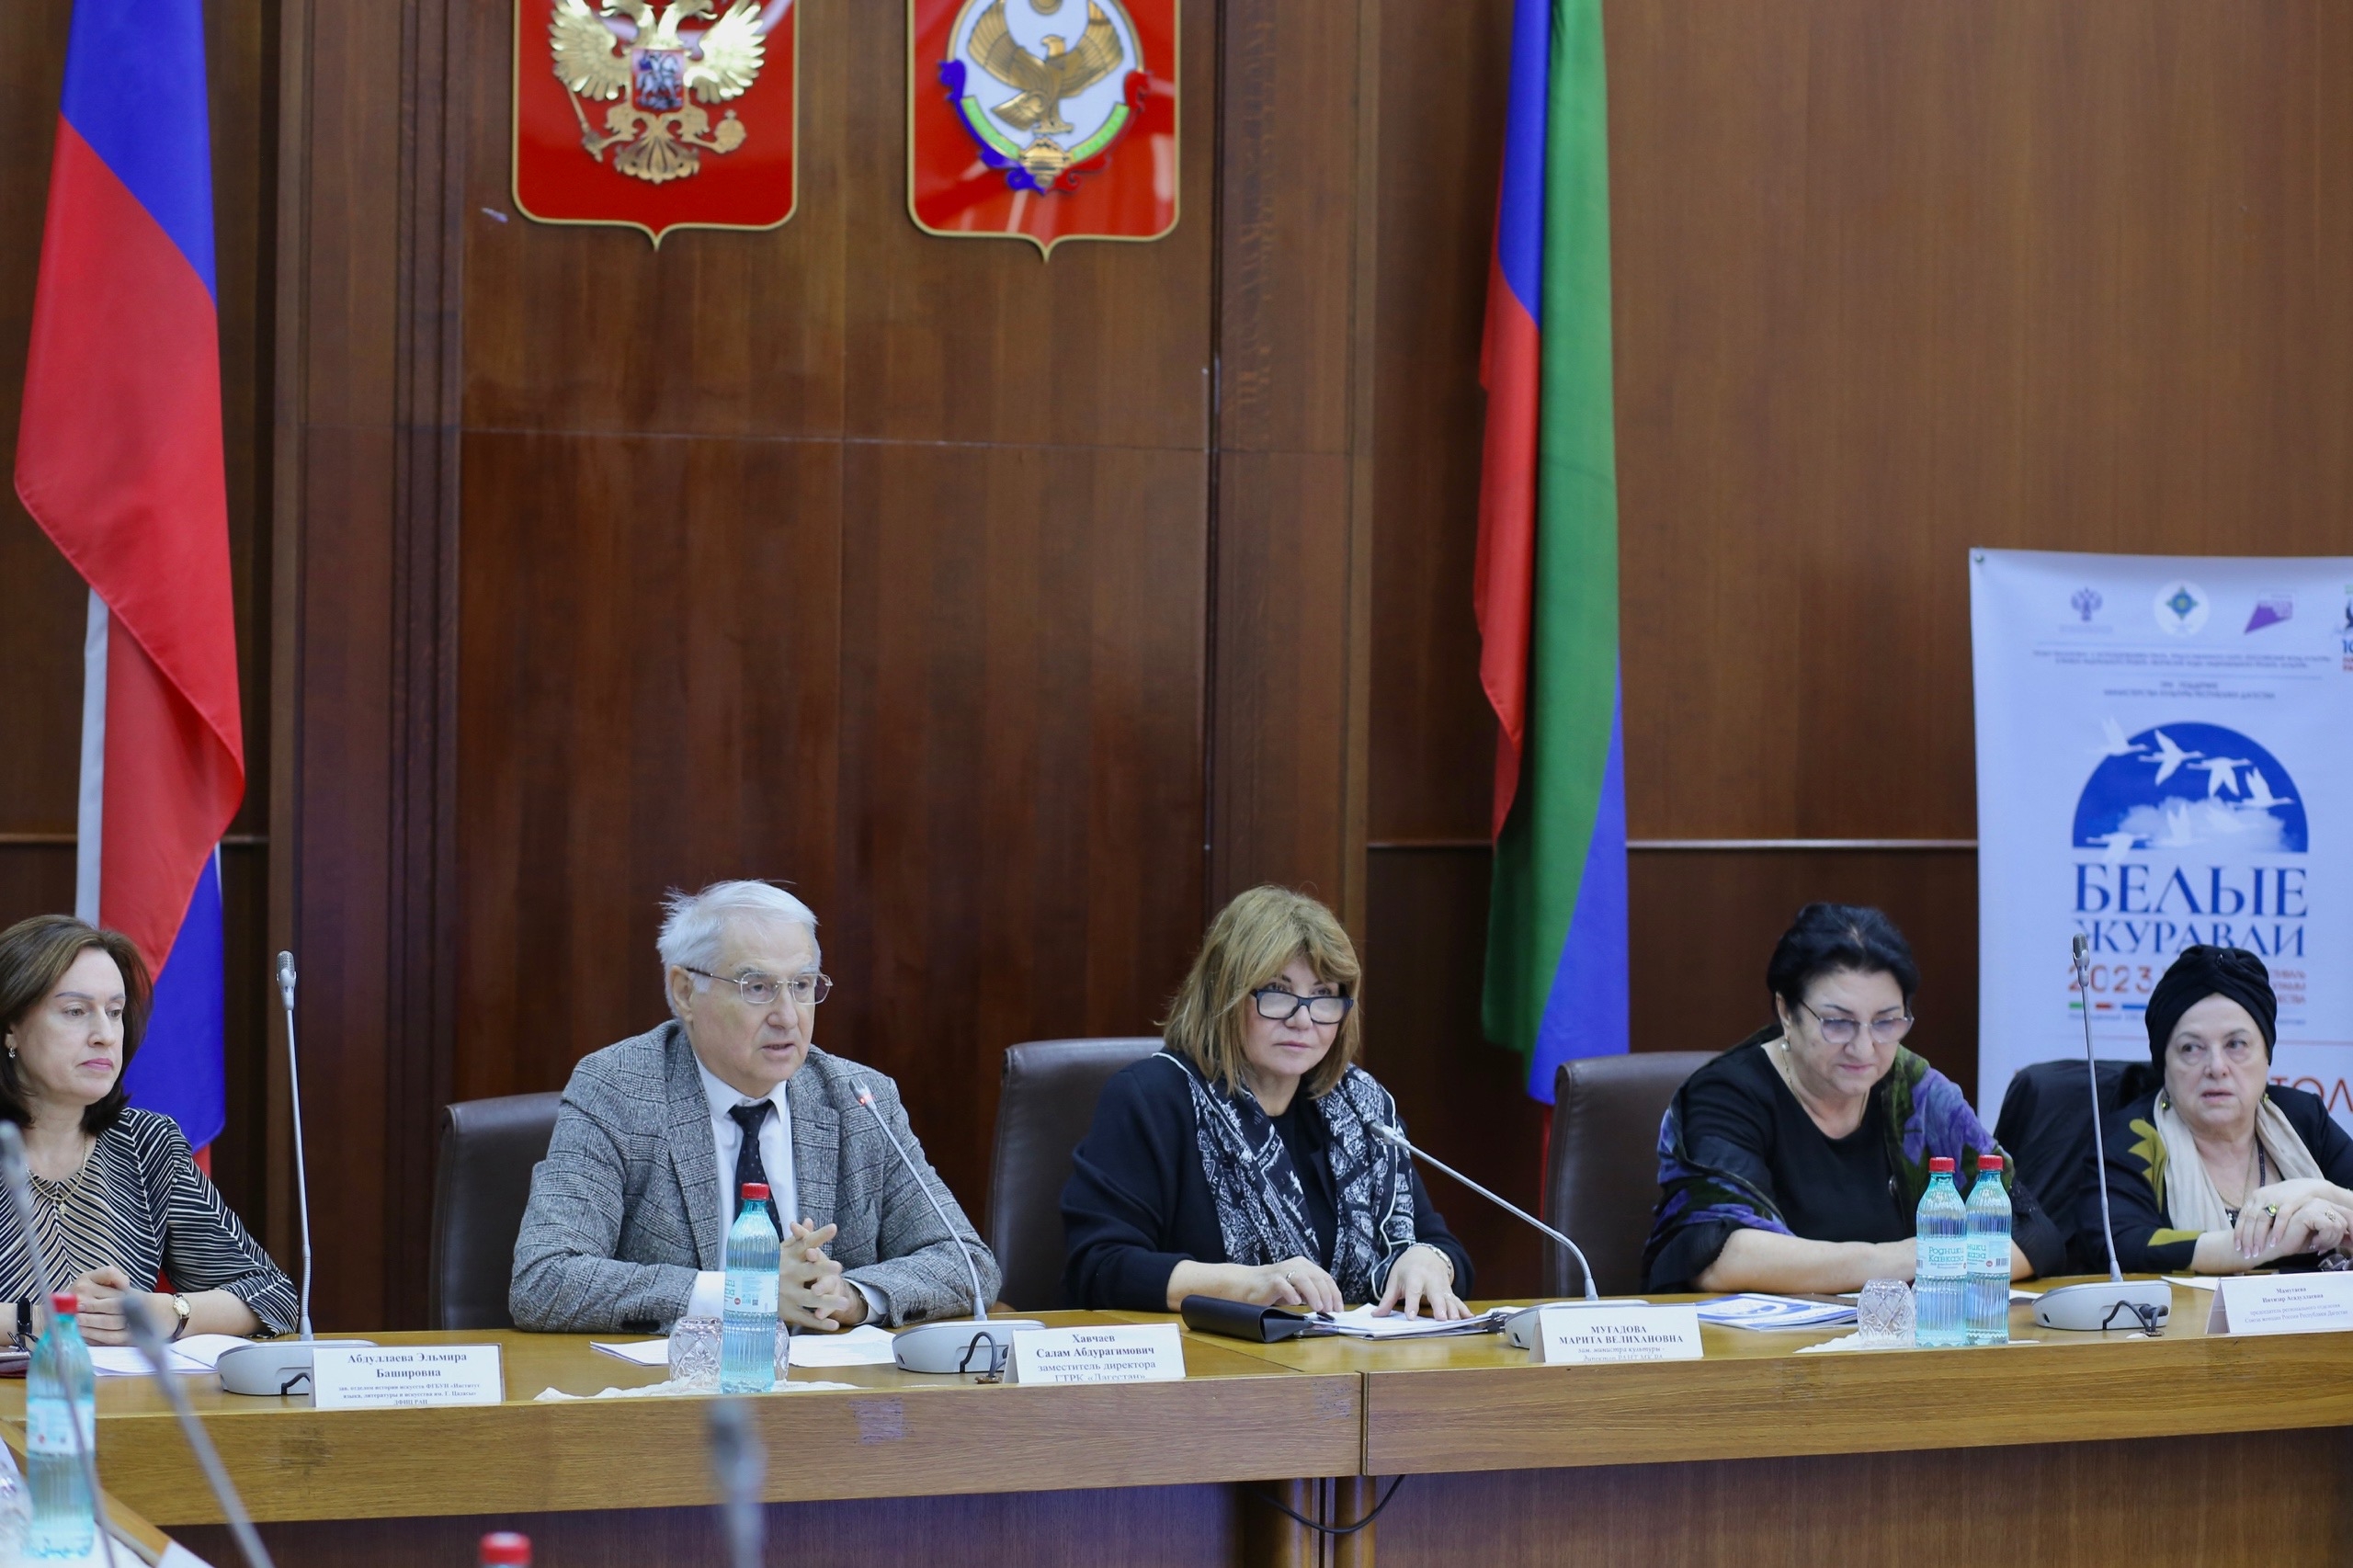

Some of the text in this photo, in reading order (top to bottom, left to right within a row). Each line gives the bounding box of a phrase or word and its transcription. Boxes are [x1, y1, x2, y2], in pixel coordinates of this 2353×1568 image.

[2072, 862, 2308, 917] БЕЛЫЕ
[2073, 918, 2303, 957] ЖУРАВЛИ
[1073, 1334, 1115, 1344] Хавчаев
[1559, 1335, 1684, 1346] МАРИТА ВЕЛИХАНОВНА
[1036, 1346, 1155, 1358] Салам Абдурагимович
[347, 1353, 467, 1365] Абдуллаева Эльмира
[1038, 1361, 1156, 1372] заместитель директора
[376, 1369, 441, 1380] Башировна
